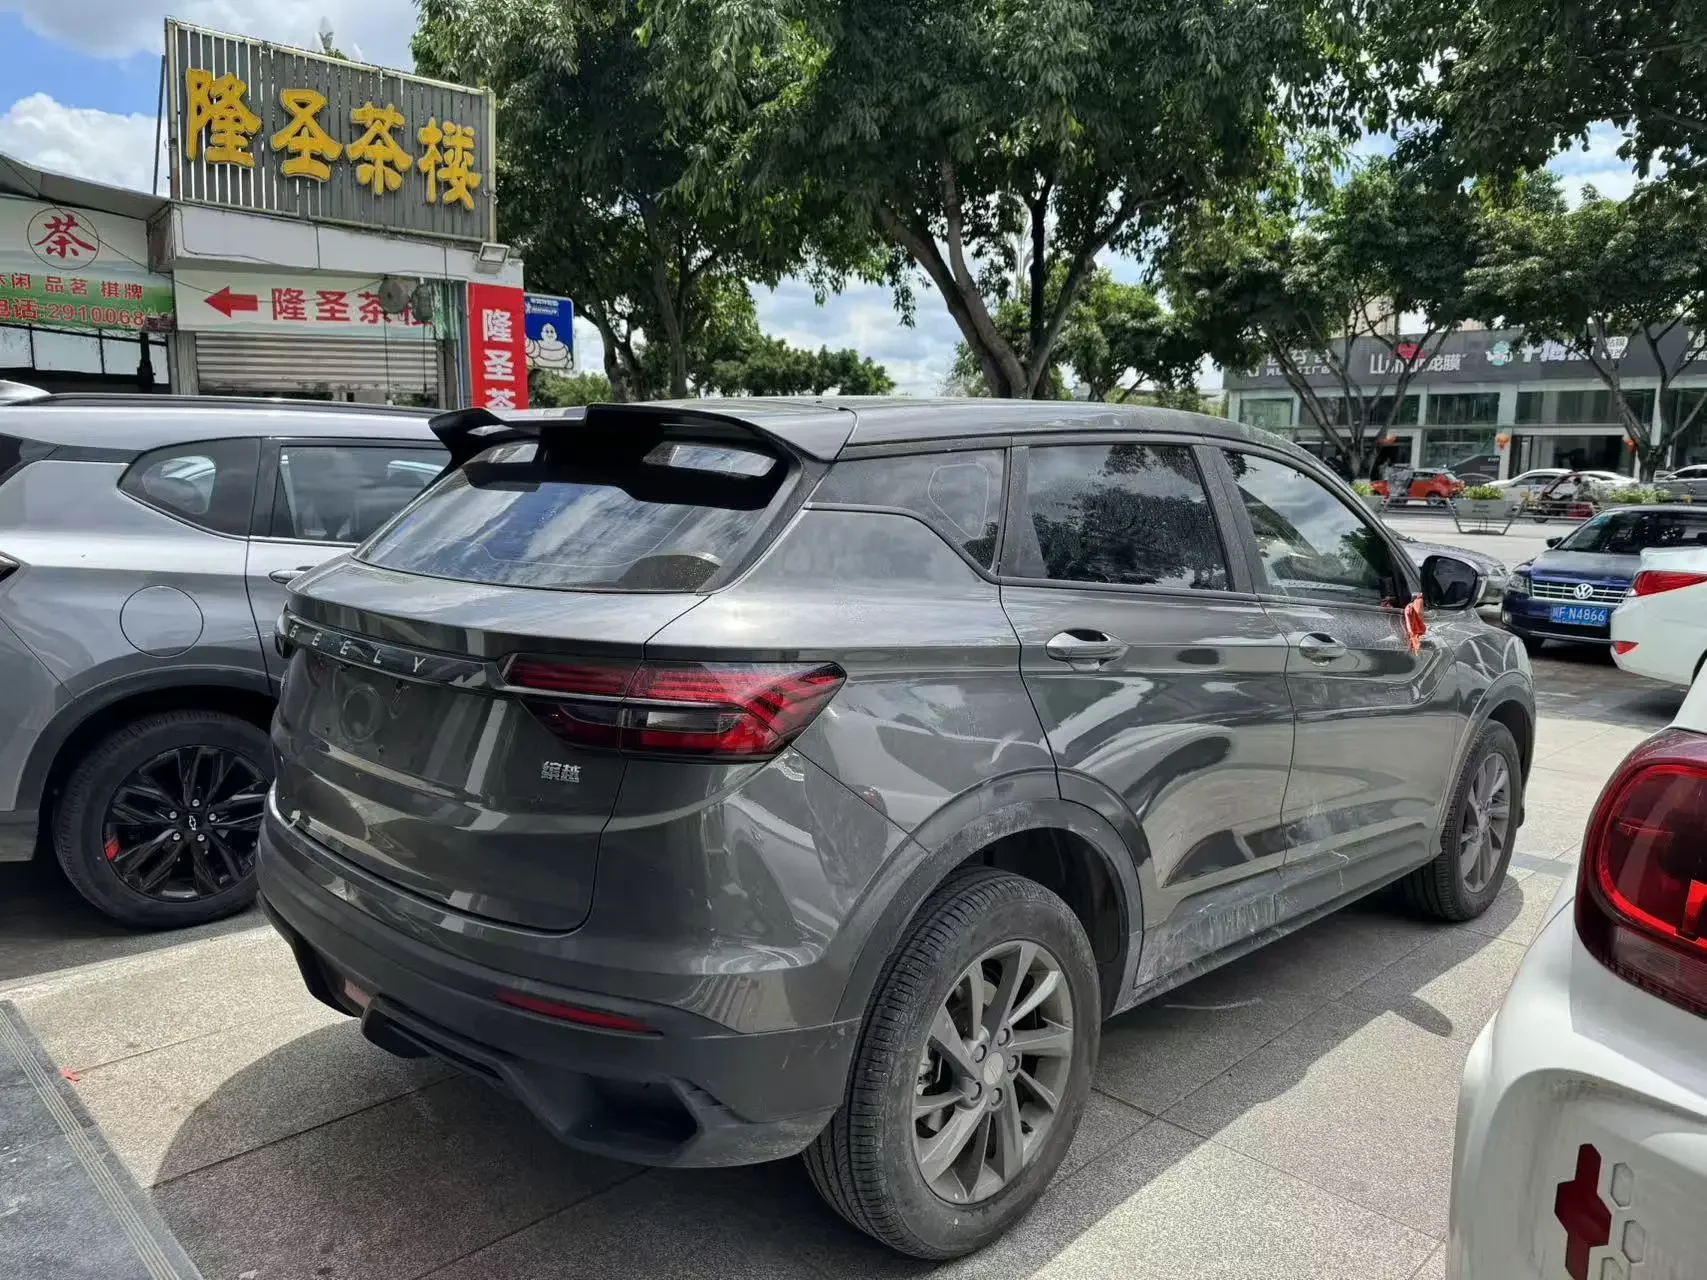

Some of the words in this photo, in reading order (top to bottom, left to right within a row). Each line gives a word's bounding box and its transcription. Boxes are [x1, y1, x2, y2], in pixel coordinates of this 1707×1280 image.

[186, 68, 482, 211] 隆圣茶楼
[34, 214, 97, 259] 茶
[45, 275, 89, 296] 品茗
[101, 280, 144, 301] 棋牌
[289, 625, 426, 672] GEELY
